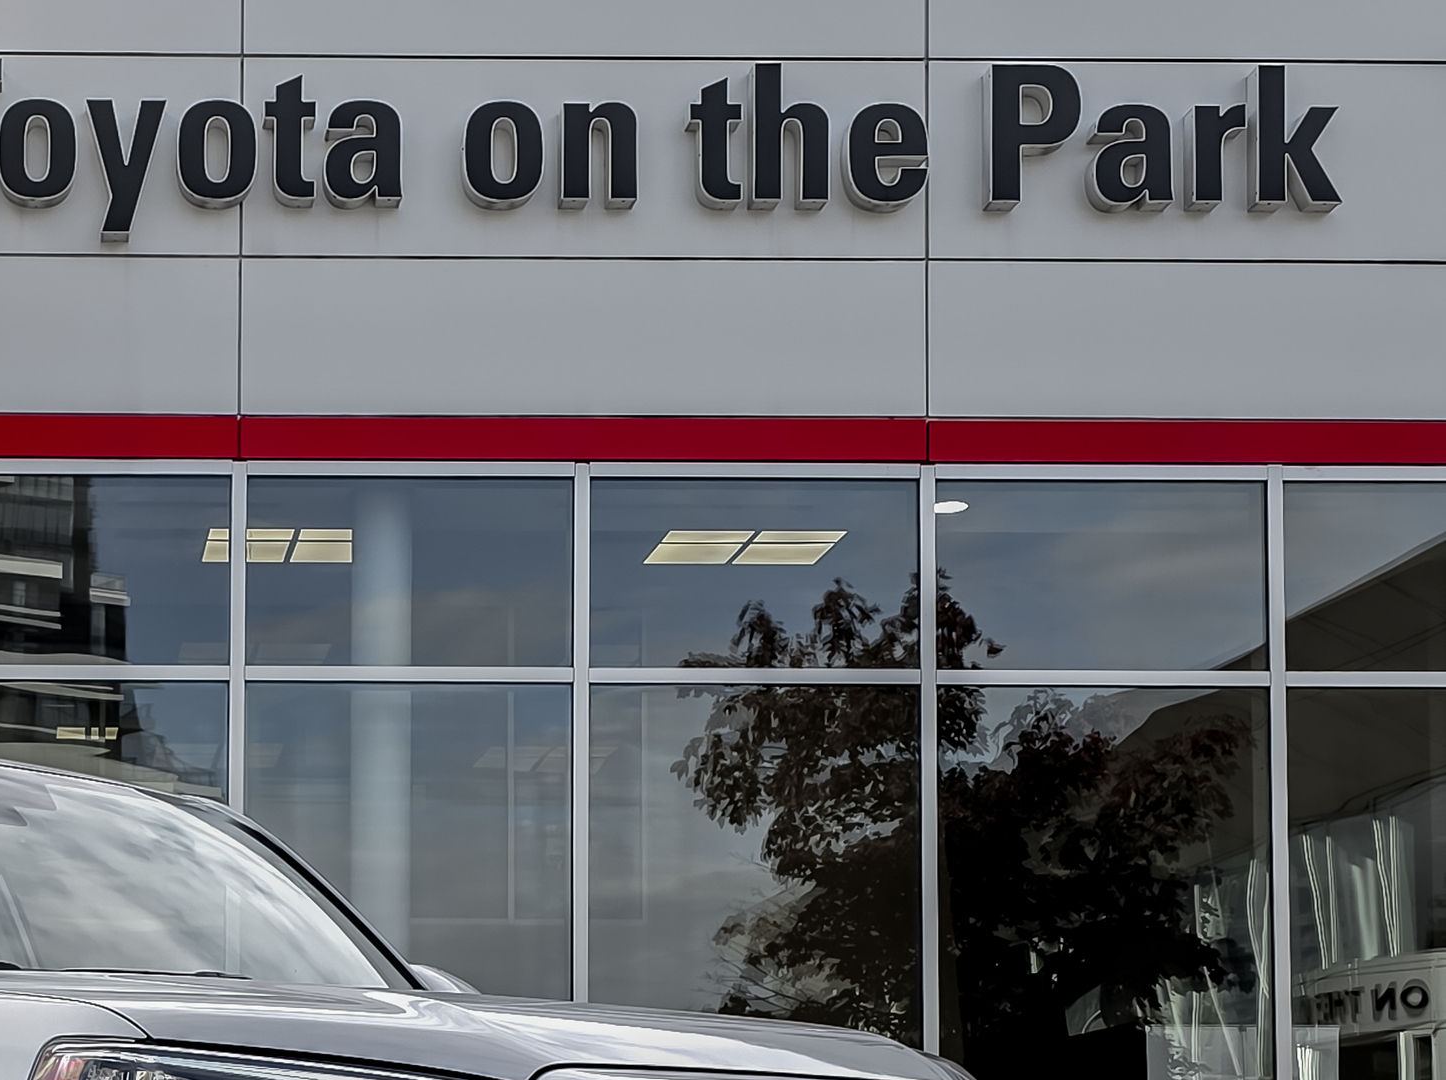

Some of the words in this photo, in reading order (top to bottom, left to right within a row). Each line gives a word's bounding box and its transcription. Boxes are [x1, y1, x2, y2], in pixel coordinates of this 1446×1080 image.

[463, 99, 639, 207] on
[686, 61, 929, 210] the
[984, 62, 1343, 211] Park
